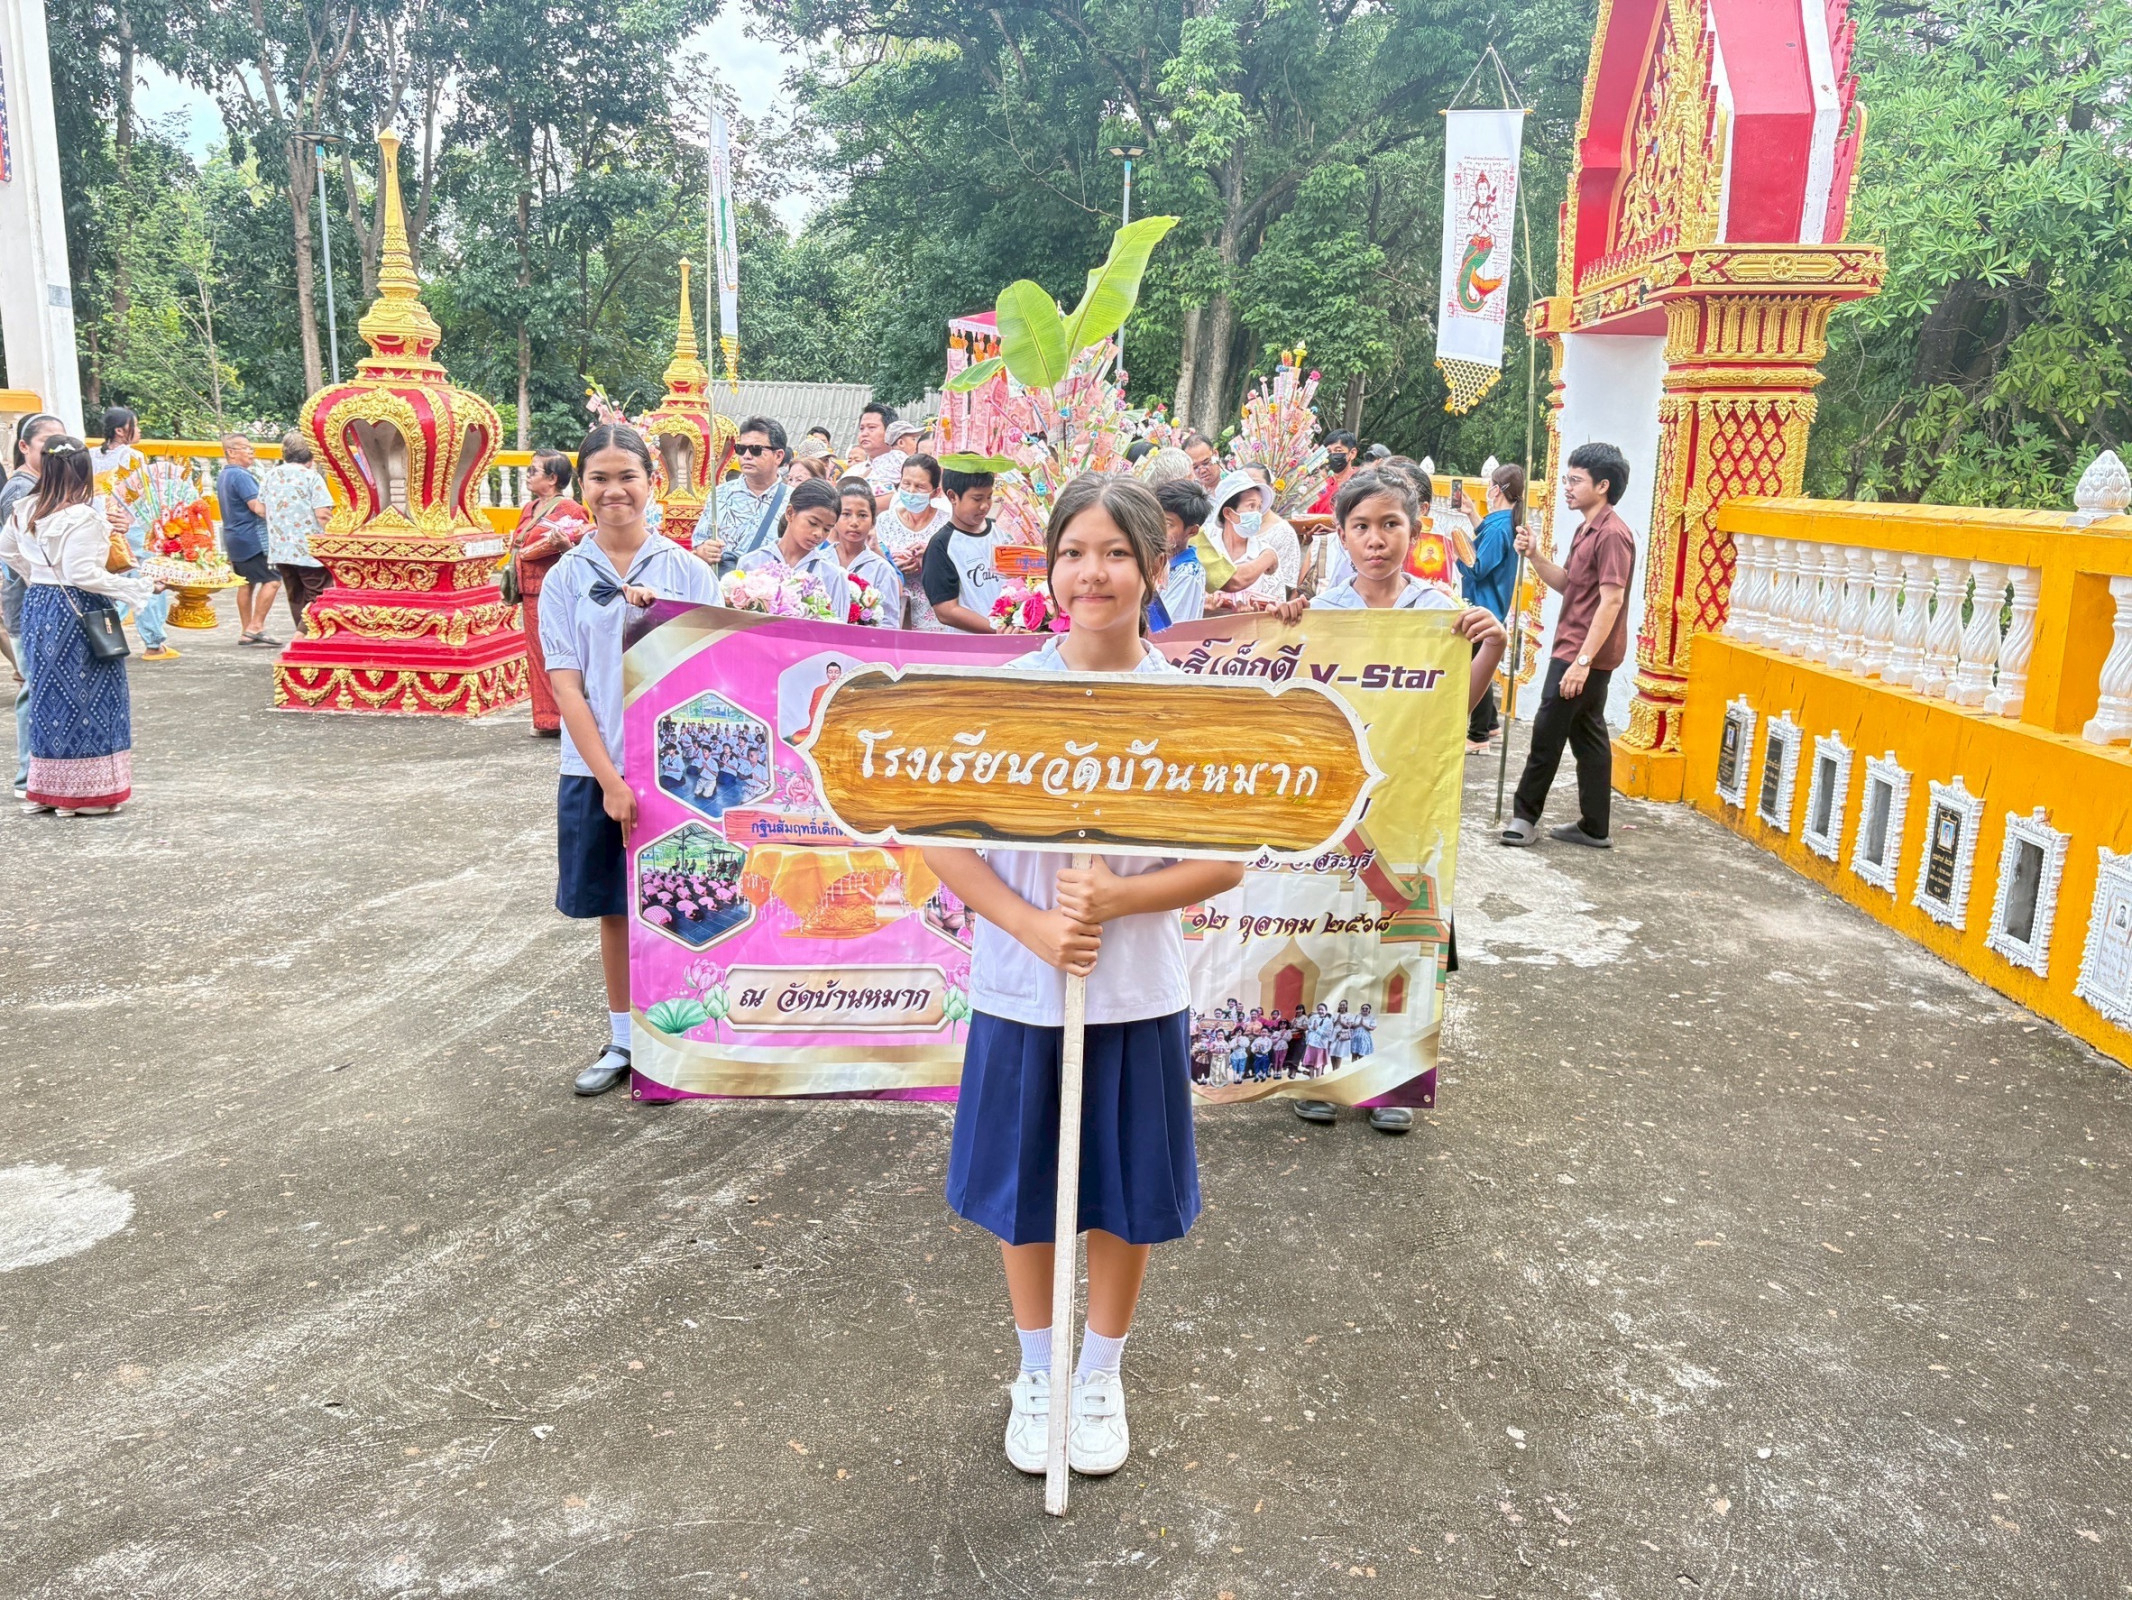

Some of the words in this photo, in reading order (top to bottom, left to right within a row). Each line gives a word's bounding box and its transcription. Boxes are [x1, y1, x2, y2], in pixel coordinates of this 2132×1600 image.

[1167, 637, 1305, 684] ธิ์เด็กดี
[857, 728, 1320, 797] โรงเรียนวัดบ้านหมาก
[1239, 914, 1318, 944] ตุลาคม
[739, 987, 767, 1008] ณ
[777, 979, 932, 1013] วัดบ้านหมาก
